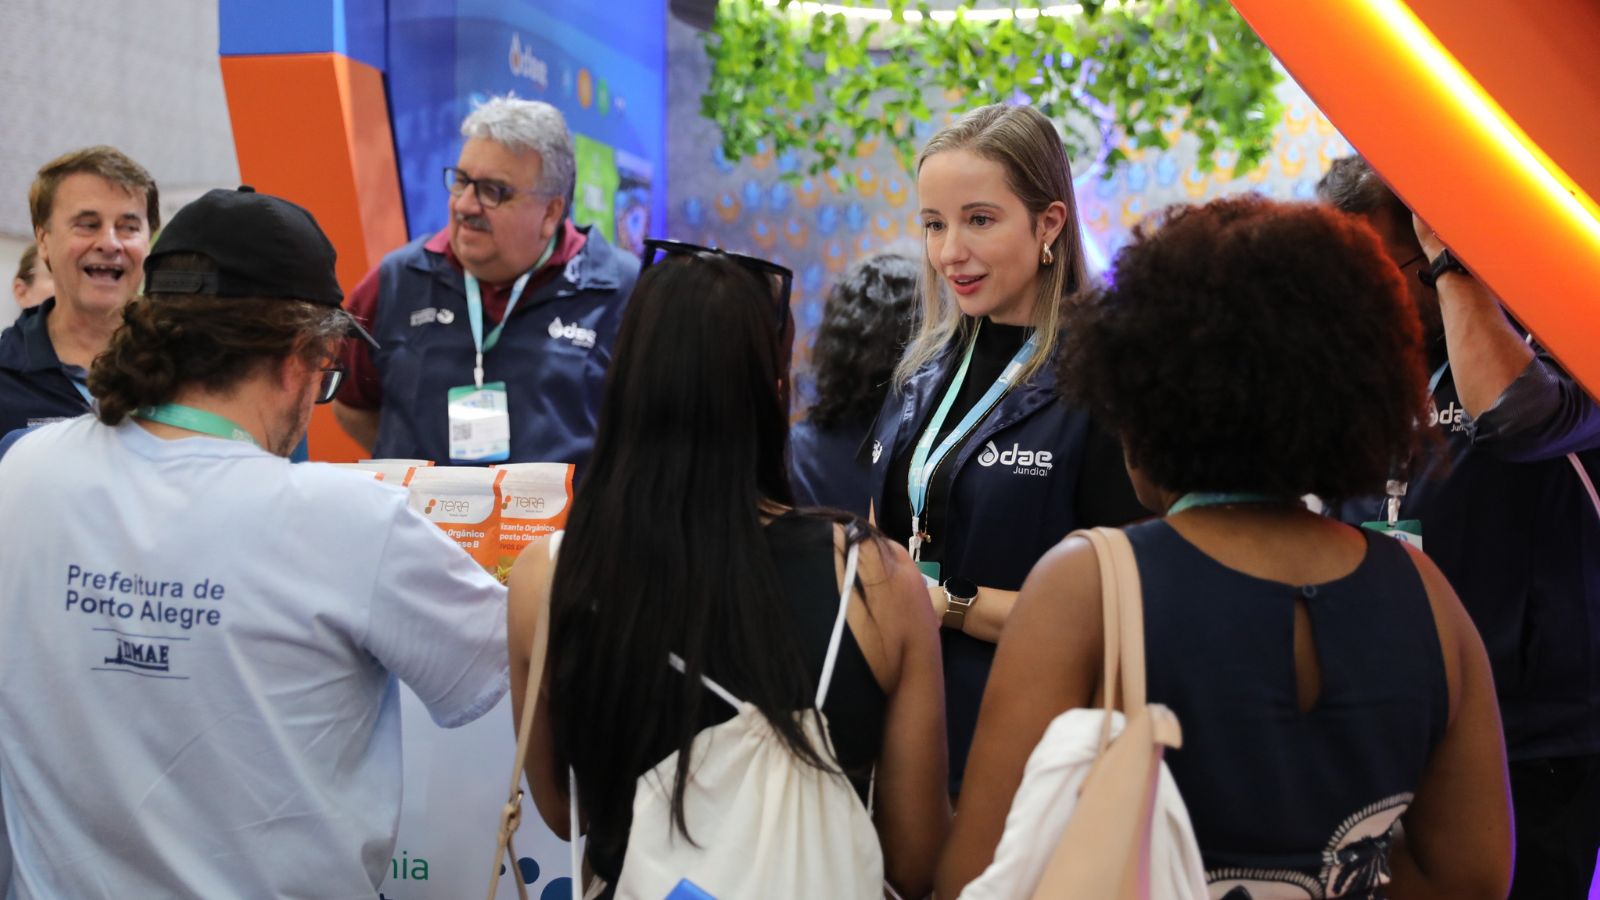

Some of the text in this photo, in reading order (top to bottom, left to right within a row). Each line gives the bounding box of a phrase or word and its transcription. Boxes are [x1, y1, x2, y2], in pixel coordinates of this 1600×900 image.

[1439, 401, 1464, 424] da
[1000, 442, 1053, 470] dae
[67, 564, 225, 600] Prefeitura de
[66, 589, 221, 630] Porto Alegre
[123, 641, 170, 665] DMAE
